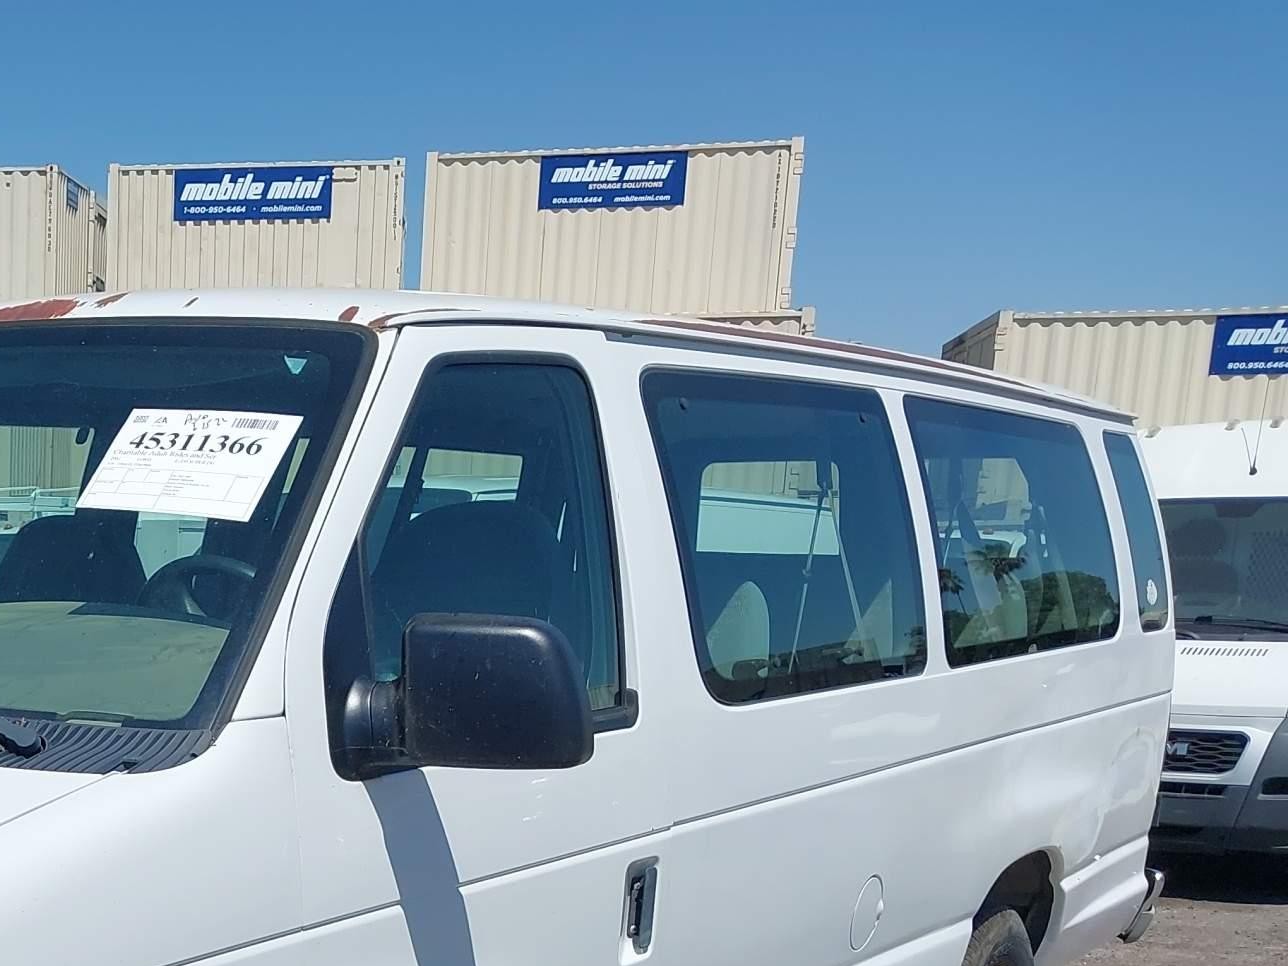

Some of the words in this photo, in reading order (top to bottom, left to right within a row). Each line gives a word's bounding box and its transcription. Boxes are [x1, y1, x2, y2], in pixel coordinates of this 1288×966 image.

[550, 158, 623, 183] mobile
[623, 159, 674, 181] mini
[180, 173, 265, 201] mobile
[266, 174, 326, 199] mini
[588, 182, 622, 190] STORAGE
[622, 181, 663, 189] SOLUTIONS
[613, 194, 671, 203] mobilemini.com
[183, 205, 246, 214] 1-800-950-6464
[260, 204, 323, 213] mobilemini.com
[129, 431, 270, 456] 45311366
